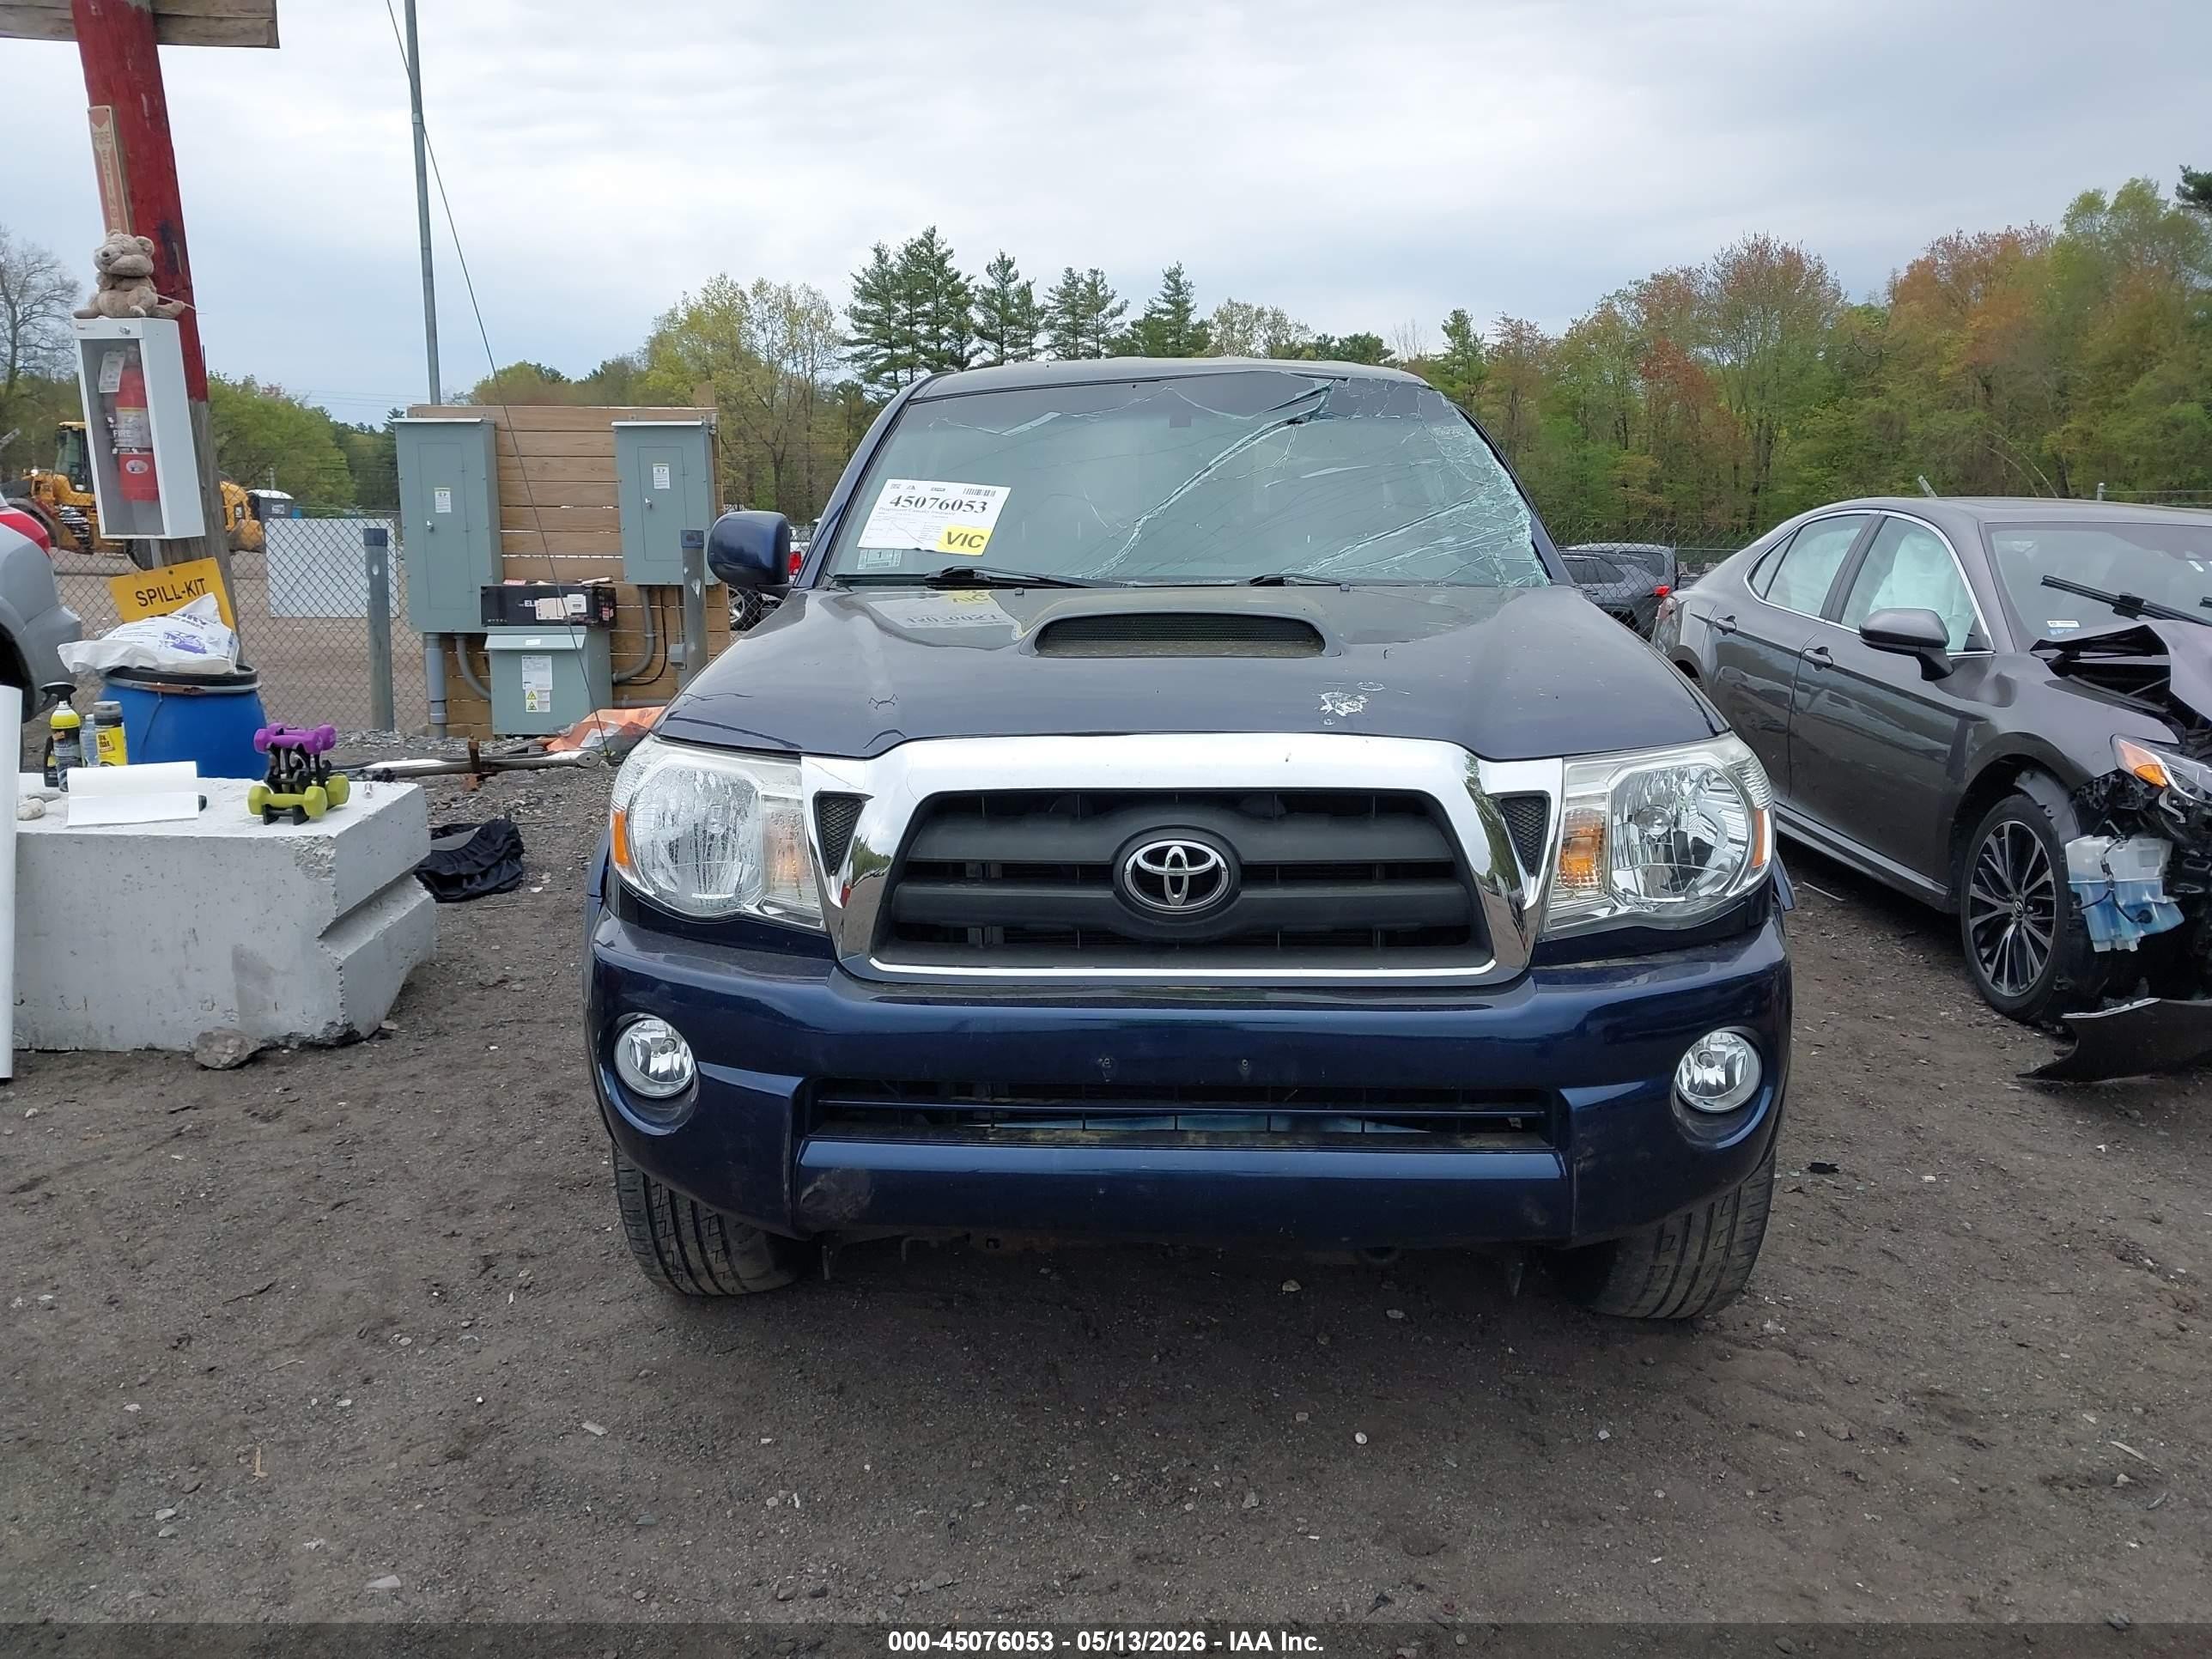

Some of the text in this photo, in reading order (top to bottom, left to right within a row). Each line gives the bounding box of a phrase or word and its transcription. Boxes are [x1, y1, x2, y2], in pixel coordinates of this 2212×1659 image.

[890, 495, 988, 514] 45076053
[947, 532, 985, 548] VIC
[135, 577, 207, 607] SPILL-KIT
